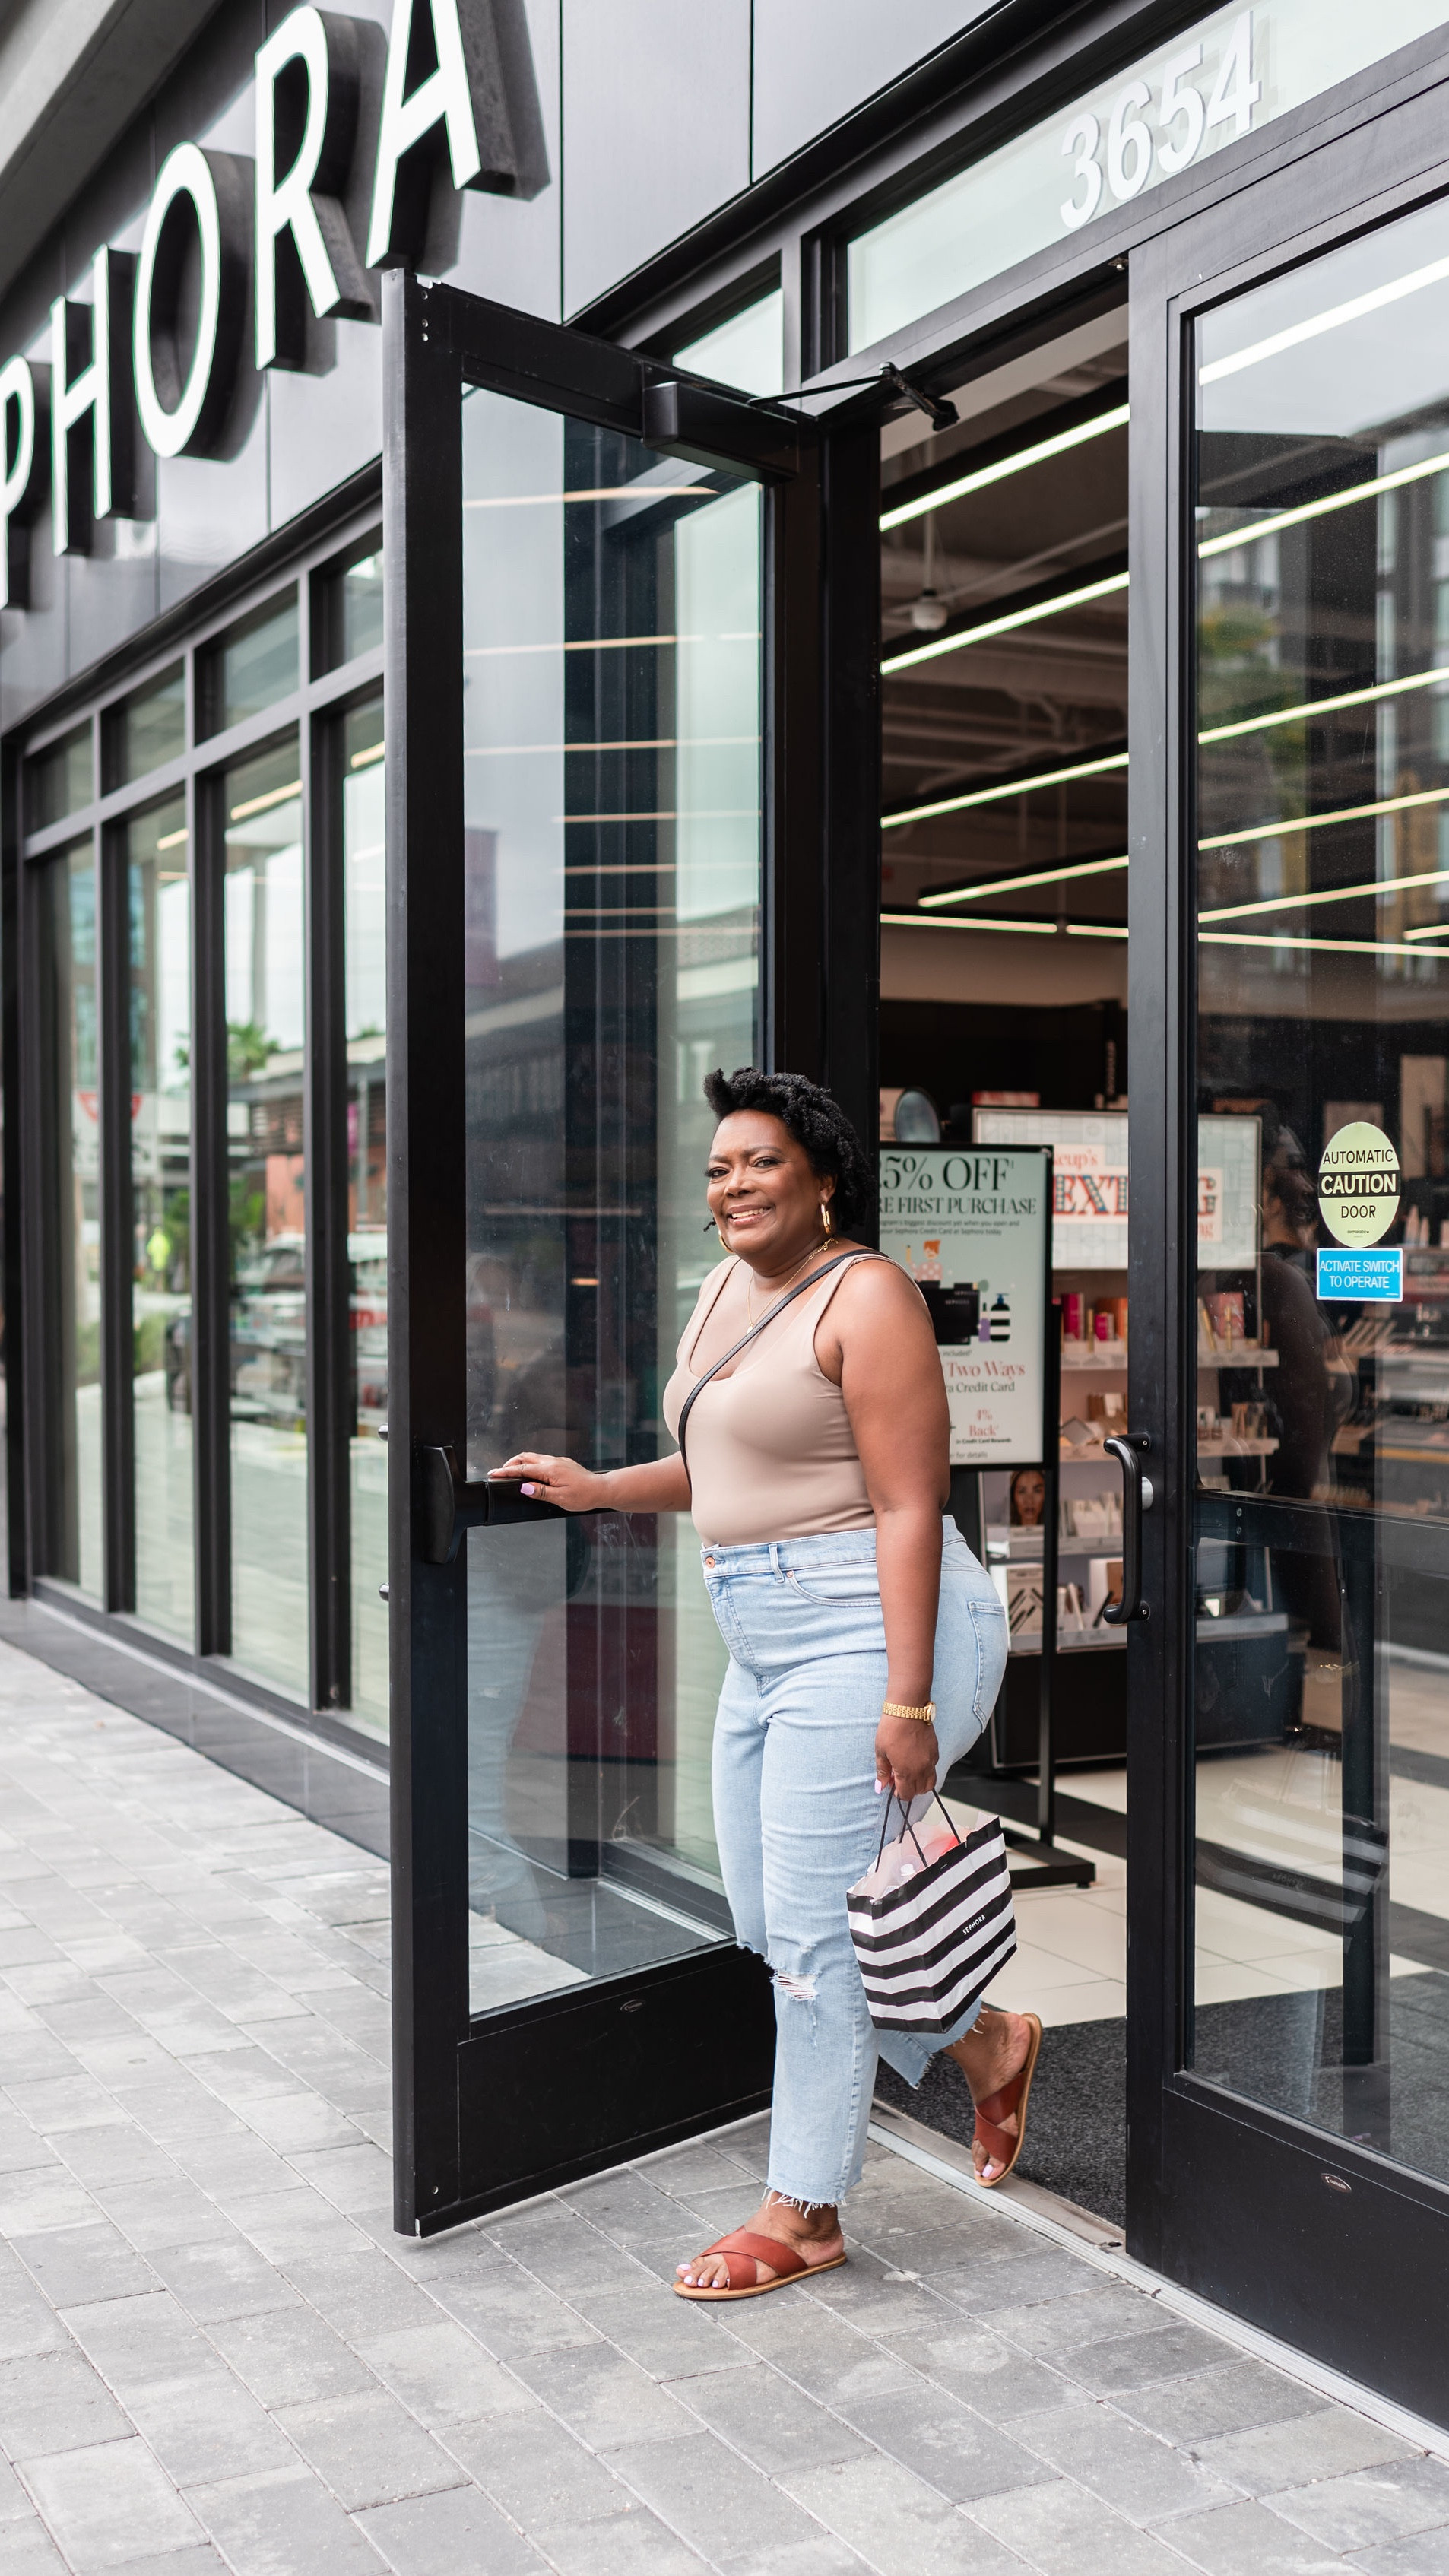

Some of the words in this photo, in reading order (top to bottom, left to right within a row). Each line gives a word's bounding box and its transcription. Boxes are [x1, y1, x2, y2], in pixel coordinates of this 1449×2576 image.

[1061, 10, 1262, 229] 3654
[1054, 1147, 1098, 1169] eup's
[1323, 1149, 1394, 1164] AUTOMATIC
[880, 1156, 933, 1191] 5%
[1321, 1174, 1396, 1194] CAUTION
[898, 1197, 944, 1214] FIRST
[948, 1198, 1037, 1215] PURCHASE
[1341, 1205, 1376, 1218] DOOR
[1320, 1260, 1361, 1272] ACTIVATE
[1362, 1260, 1400, 1273] SWITCH
[1329, 1275, 1342, 1288] TO
[1344, 1275, 1390, 1289] OPERATE
[947, 1361, 981, 1377] Two
[984, 1360, 1026, 1380] Ways
[956, 1381, 988, 1393] Credit
[991, 1381, 1015, 1393] Card
[962, 1915, 985, 1935] SEPHORA
